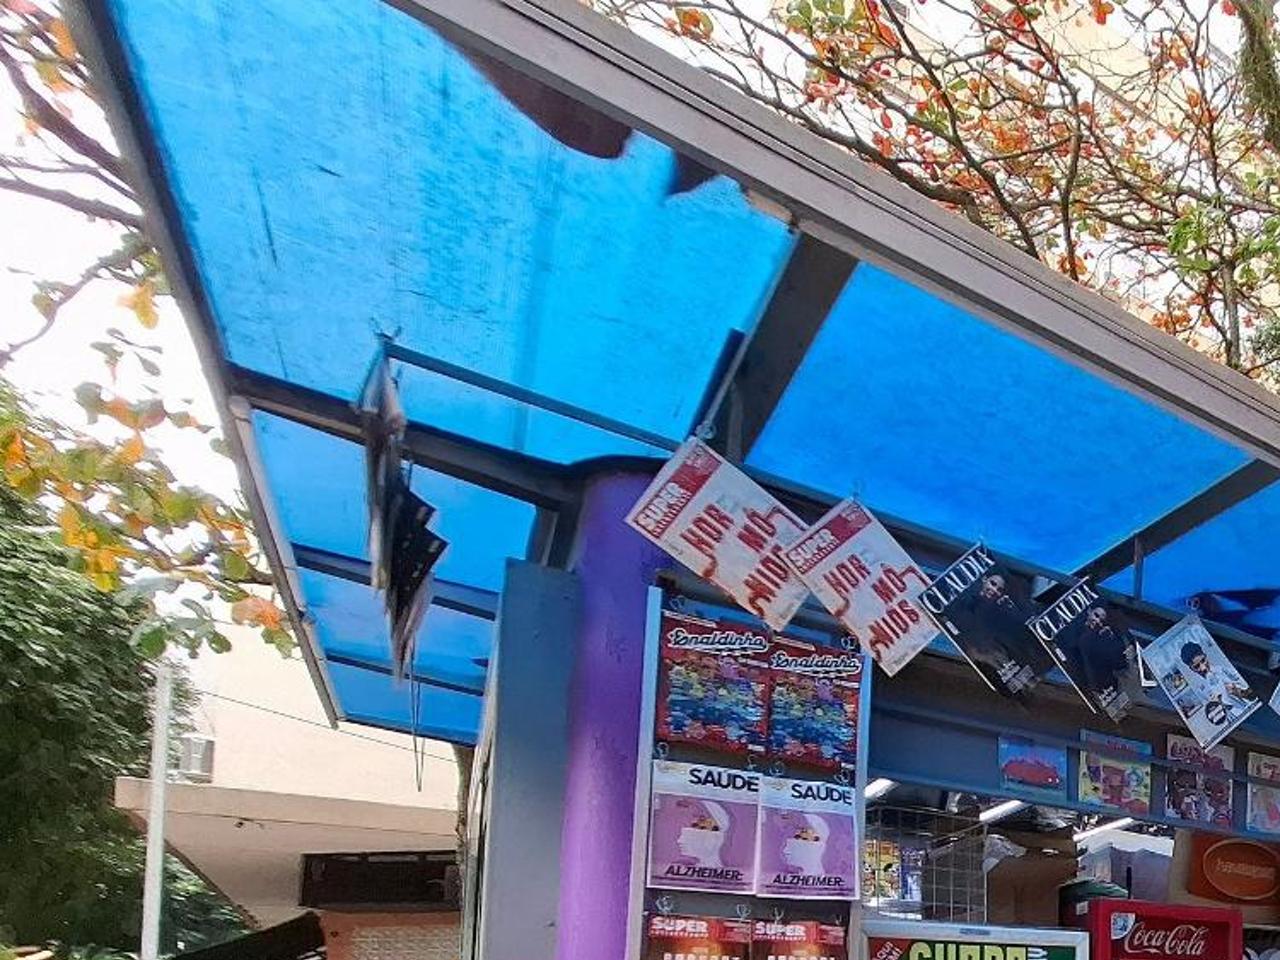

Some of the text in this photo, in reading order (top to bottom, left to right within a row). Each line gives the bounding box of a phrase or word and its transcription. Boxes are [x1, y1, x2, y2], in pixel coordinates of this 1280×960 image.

[786, 528, 839, 566] SUPER
[923, 547, 995, 613] CLAUDIA
[1035, 582, 1099, 641] CLAUDIA
[651, 916, 709, 934] SUPER
[755, 921, 807, 937] SUPER
[1124, 921, 1209, 956] Coca-Cola
